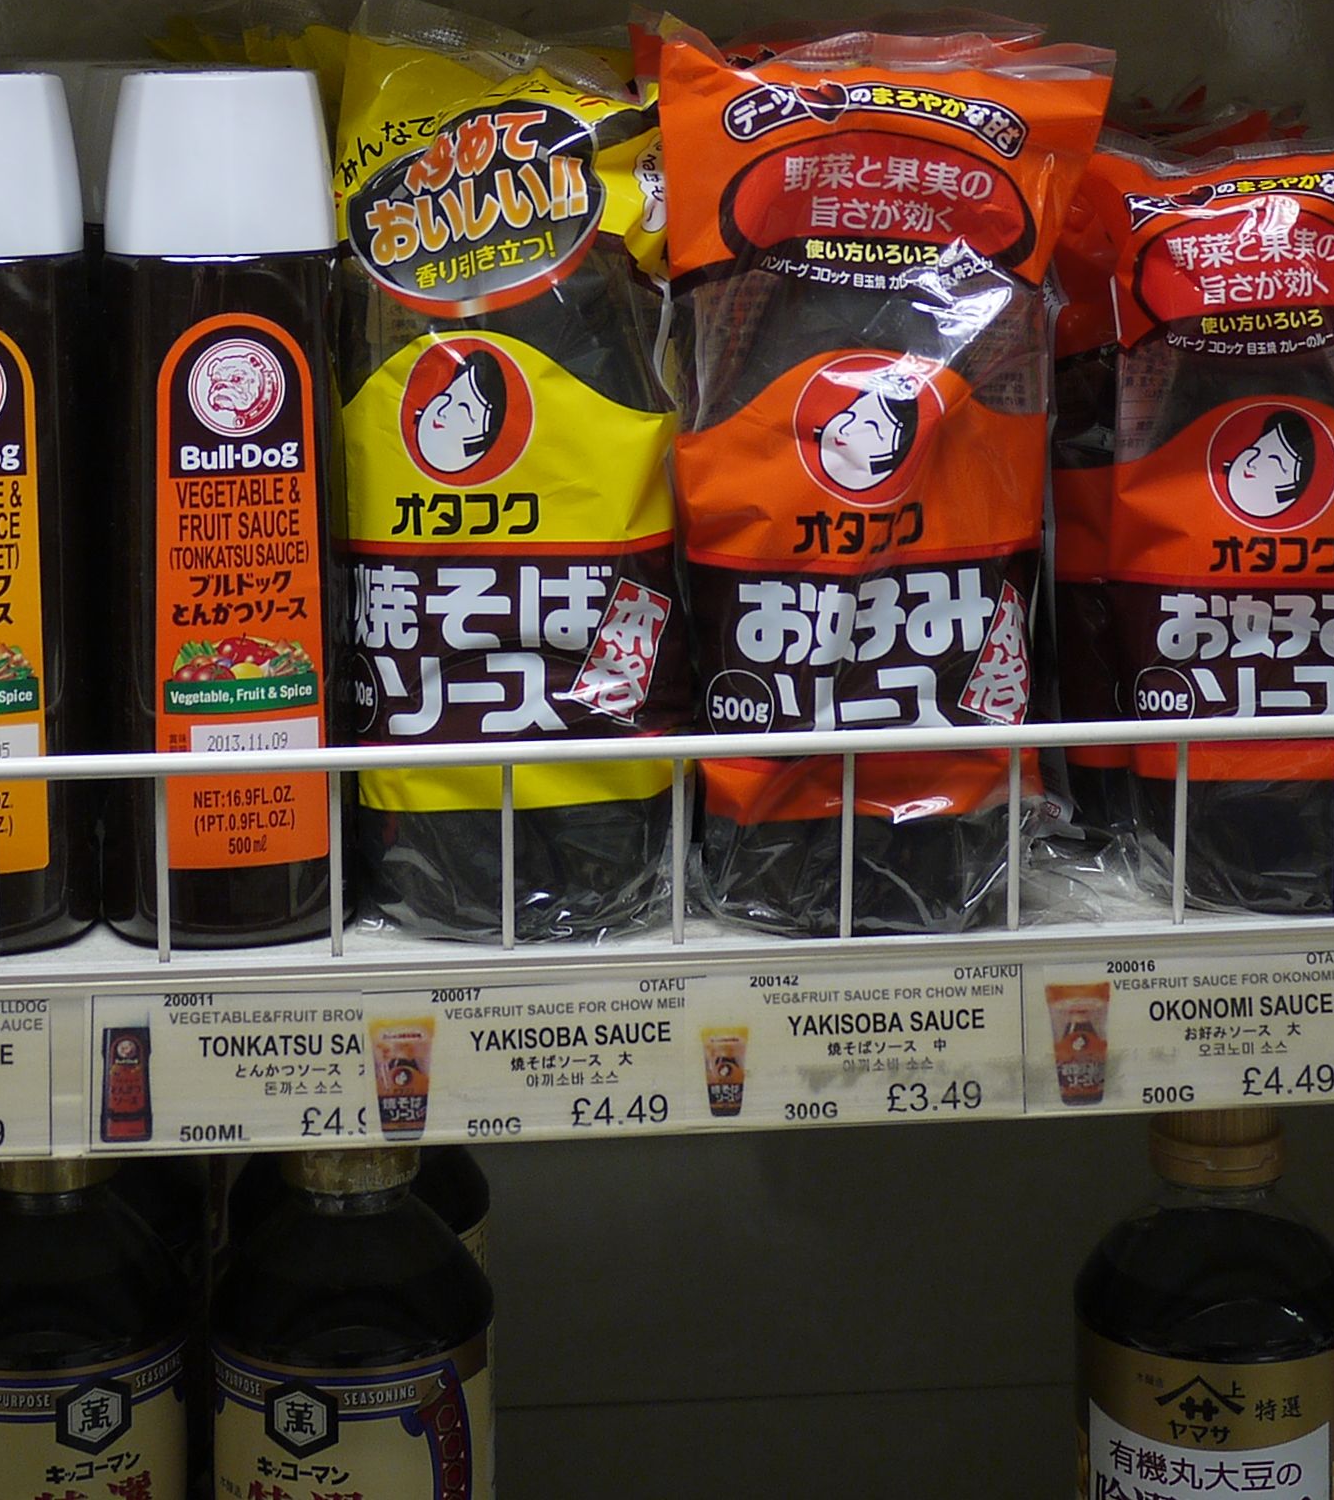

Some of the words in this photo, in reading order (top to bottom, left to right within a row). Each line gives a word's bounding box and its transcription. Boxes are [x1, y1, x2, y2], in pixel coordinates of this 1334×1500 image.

[784, 155, 993, 200] 野菜と果実の
[811, 198, 953, 233] 旨さが効く
[805, 240, 940, 265] 使い方いろいろ
[176, 477, 283, 508] VEGETABLE
[289, 478, 301, 502] &
[179, 514, 230, 541] FRUIT
[238, 509, 299, 538] SAUCE
[392, 493, 539, 535] オタフク
[793, 502, 923, 554] オタフク
[170, 545, 254, 570] (TONKATSU
[256, 540, 310, 564] SAUCE)
[189, 571, 292, 597] ブルドック
[172, 598, 307, 626] とんかつソース
[355, 564, 612, 649] 焼そば
[737, 568, 995, 666] お好み
[374, 653, 567, 735] ソース
[1138, 688, 1188, 712] 300g
[712, 696, 768, 723] 500g
[207, 732, 288, 752] 2013.11.09
[954, 965, 1018, 980] OTAFUKU
[788, 1012, 903, 1036] YAKISOBA
[910, 1009, 985, 1030] SAUCE
[1149, 997, 1253, 1021] OKONOMI
[1260, 994, 1333, 1016] SAUCE
[199, 1035, 323, 1057] TONKATSU
[471, 1025, 588, 1051] YAKISOBA
[595, 1021, 671, 1046] SAUCE
[1243, 1064, 1334, 1096] £4.49
[888, 1081, 982, 1112] £3.49
[468, 1118, 521, 1137] 500G
[572, 1094, 668, 1127] £4.49
[180, 1125, 250, 1142] 500ML
[344, 1384, 415, 1406] SEASONING
[1255, 1395, 1303, 1421] 特選
[1168, 1419, 1230, 1444] ヤマサ
[46, 1452, 140, 1484] キッコーマン
[1109, 1439, 1302, 1492] 有機丸大豆の
